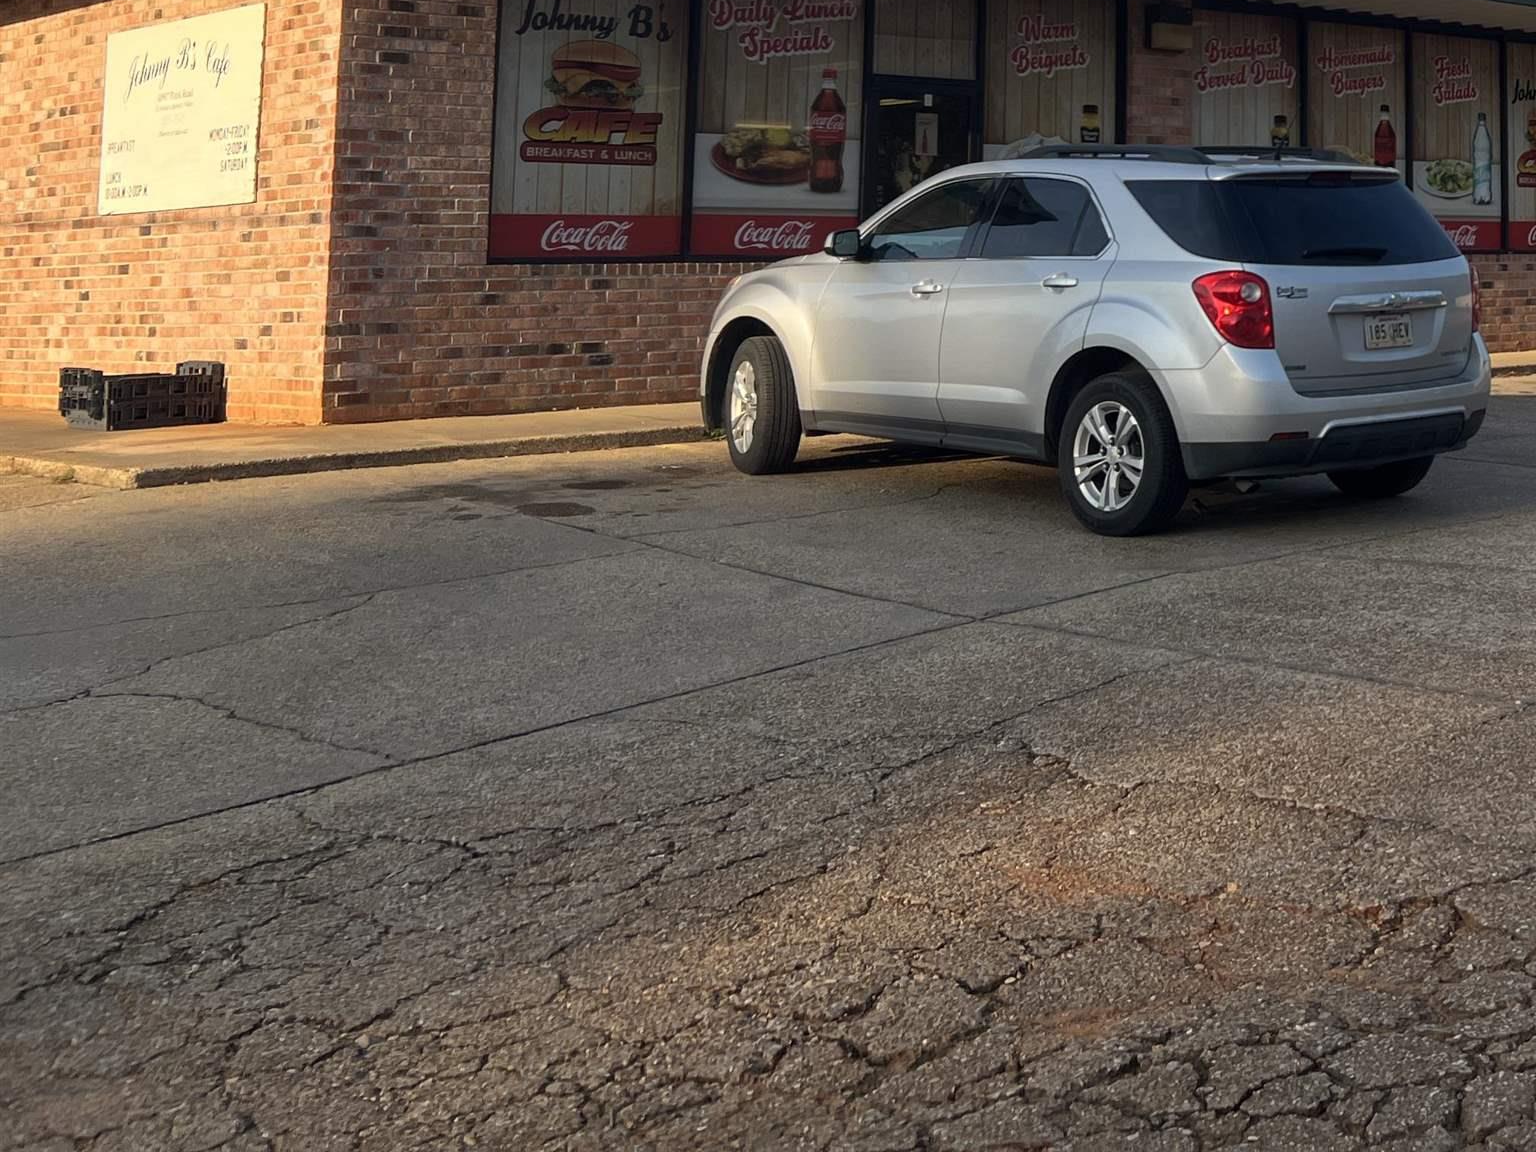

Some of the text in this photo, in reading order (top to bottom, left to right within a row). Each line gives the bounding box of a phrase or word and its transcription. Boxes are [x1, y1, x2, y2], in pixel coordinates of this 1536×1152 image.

[628, 3, 673, 42] B's
[1017, 15, 1079, 44] Warm
[739, 24, 836, 65] Specials
[1011, 44, 1091, 77] Beignets
[1204, 33, 1284, 66] Breakfast
[1314, 44, 1395, 71] Homemade
[124, 37, 231, 105] Johnny B's Cafe
[1193, 60, 1296, 93] Served Daily
[1434, 54, 1473, 81] Fresh
[1329, 70, 1387, 99] Burgers
[1431, 79, 1479, 106] Salads
[522, 107, 663, 145] CAFE
[526, 146, 653, 162] BREAKFAST & LUNCH
[541, 220, 634, 252] Coca-Cola
[734, 220, 816, 250] Coca-Cola
